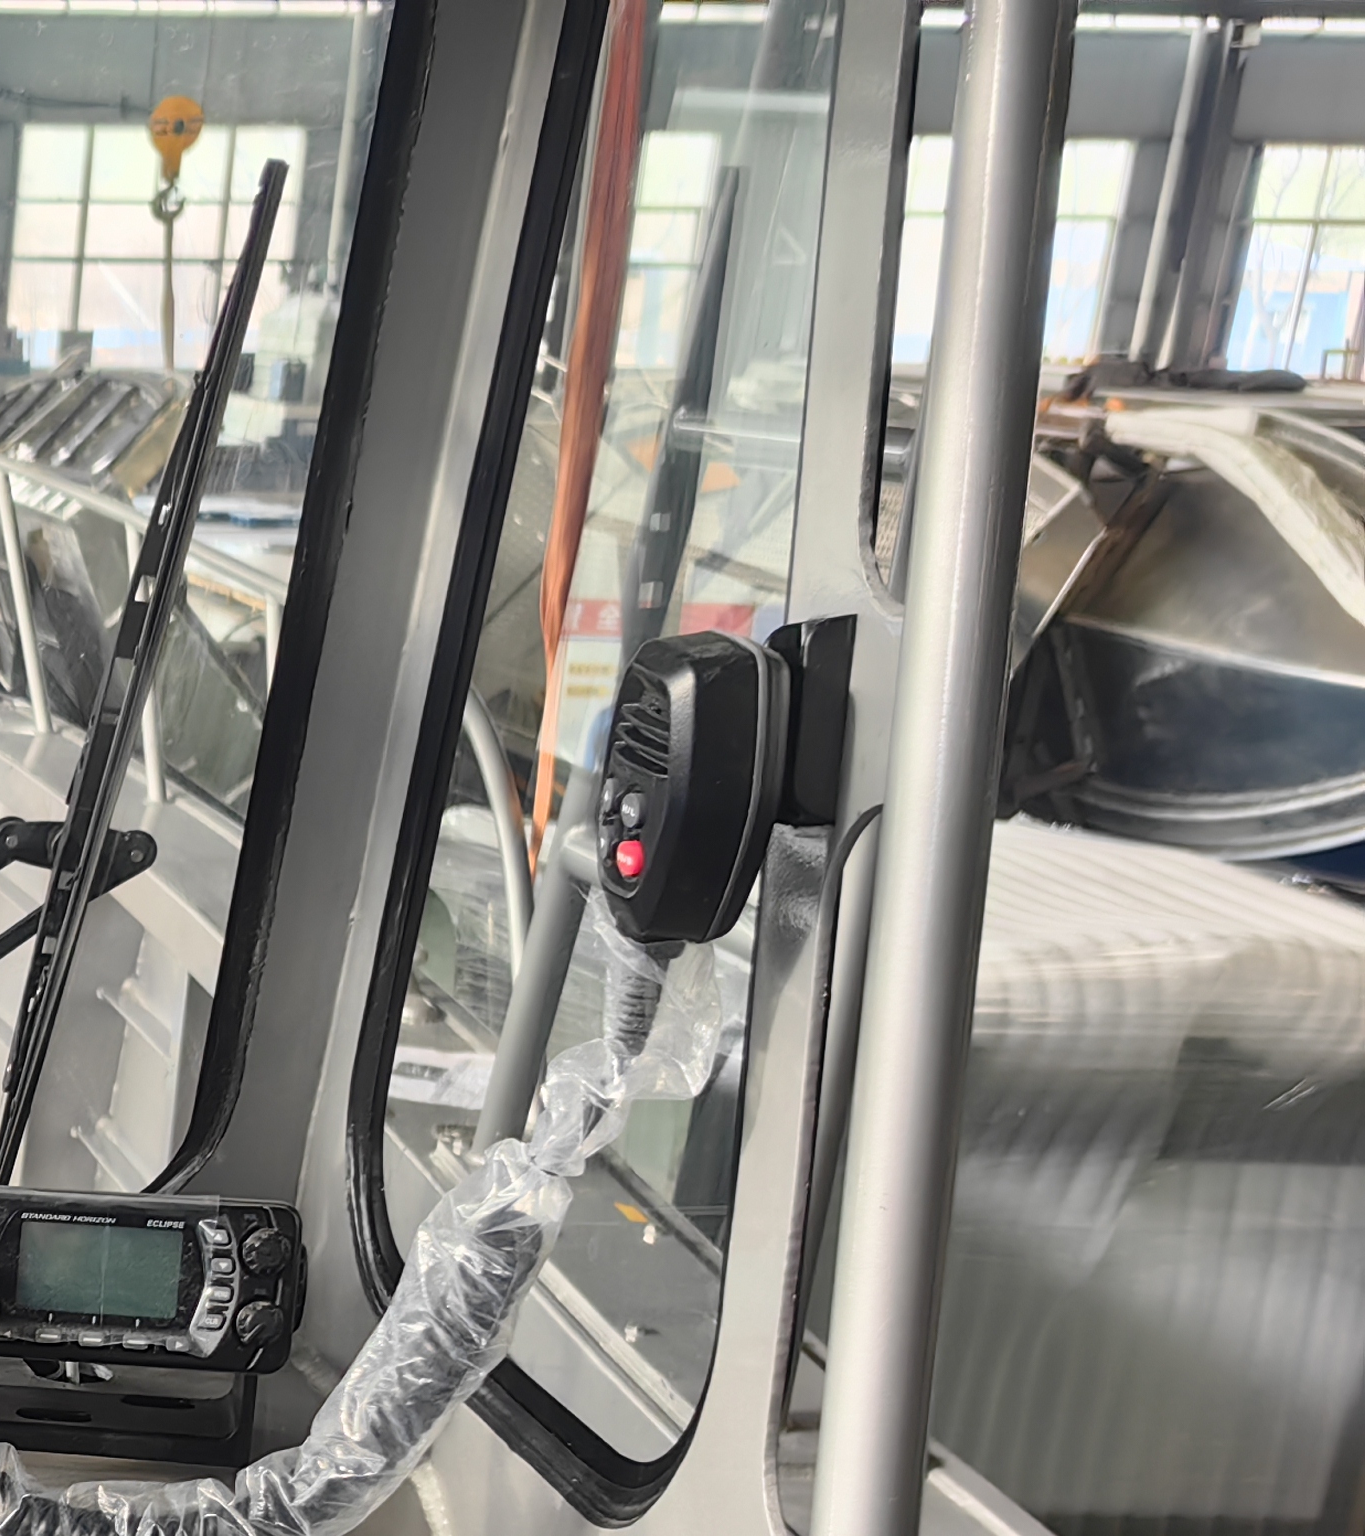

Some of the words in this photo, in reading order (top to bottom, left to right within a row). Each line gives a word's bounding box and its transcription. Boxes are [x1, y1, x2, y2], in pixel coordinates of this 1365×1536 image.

[20, 1212, 72, 1222] STANDARD
[72, 1215, 117, 1224] HORIZON
[146, 1218, 187, 1230] ECLIPSE
